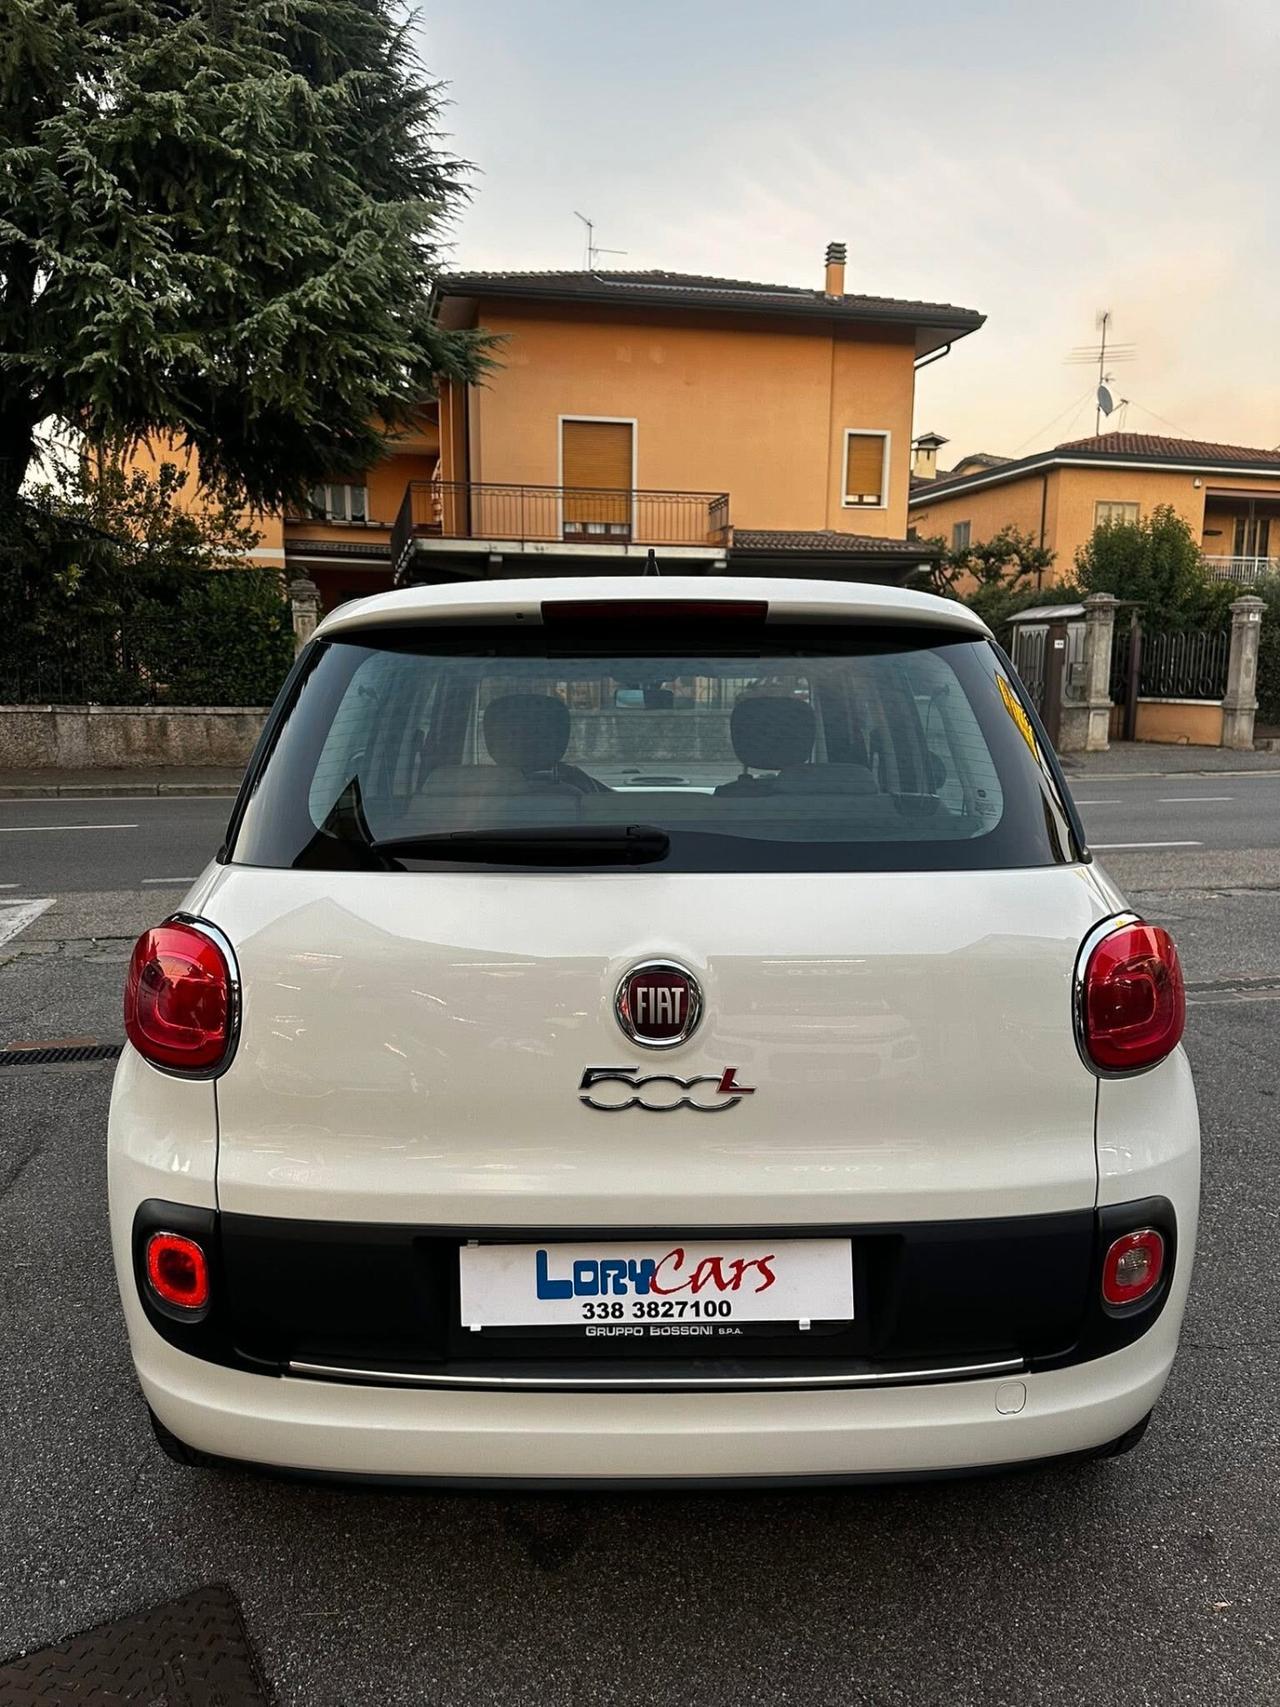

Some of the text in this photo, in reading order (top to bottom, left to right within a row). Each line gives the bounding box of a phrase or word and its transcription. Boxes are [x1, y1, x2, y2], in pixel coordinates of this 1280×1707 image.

[637, 987, 685, 1024] FIAT
[579, 1065, 757, 1112] 500L
[582, 1300, 732, 1319] 338 3827100
[585, 1326, 644, 1336] GRUPPO
[650, 1326, 713, 1335] BOSSONI
